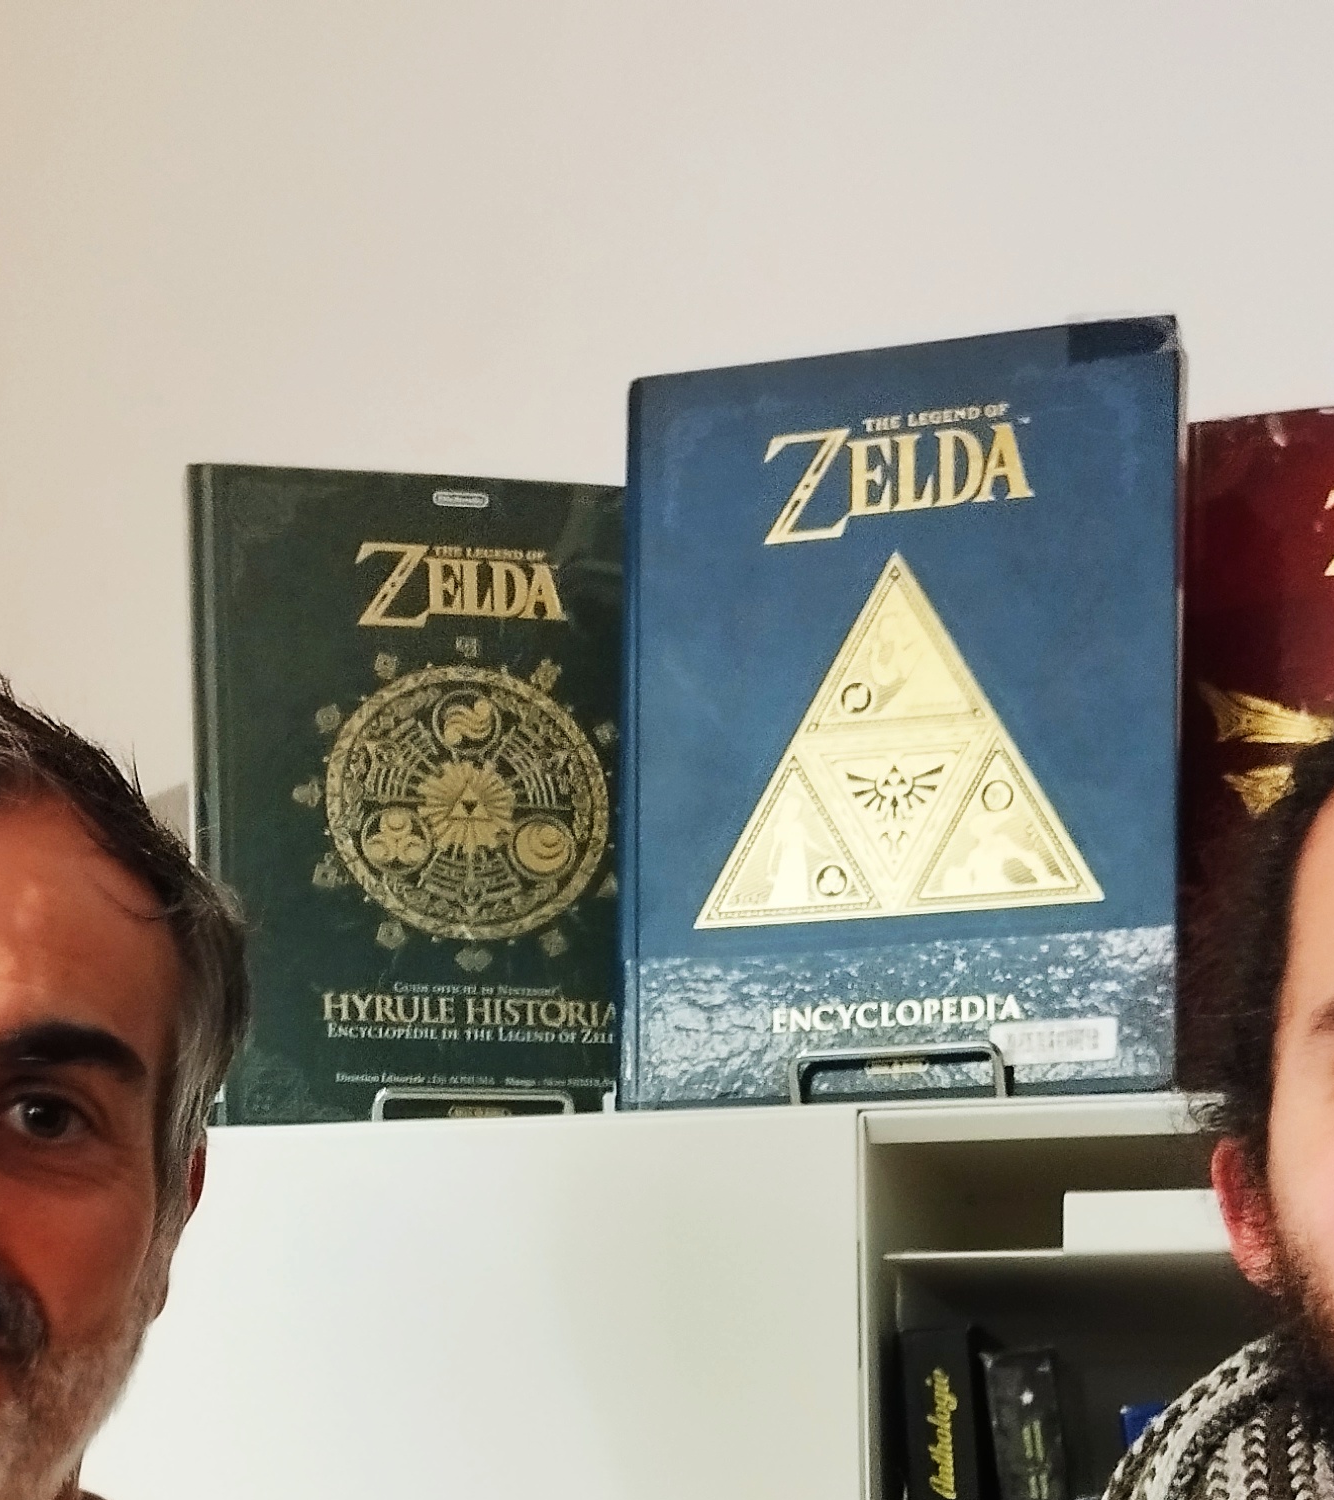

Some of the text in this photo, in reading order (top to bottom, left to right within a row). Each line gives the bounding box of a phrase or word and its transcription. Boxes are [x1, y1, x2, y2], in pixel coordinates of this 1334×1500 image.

[862, 403, 1010, 432] THE LEGEND OF
[764, 427, 1036, 545] ZELDA
[432, 546, 463, 558] THE
[466, 547, 524, 560] LEGEND
[355, 542, 568, 628] ZELDA
[323, 991, 455, 1023] HYRULE
[772, 994, 1023, 1034] ENCYCLOPEDIA
[925, 1367, 958, 1500] Anthologie
